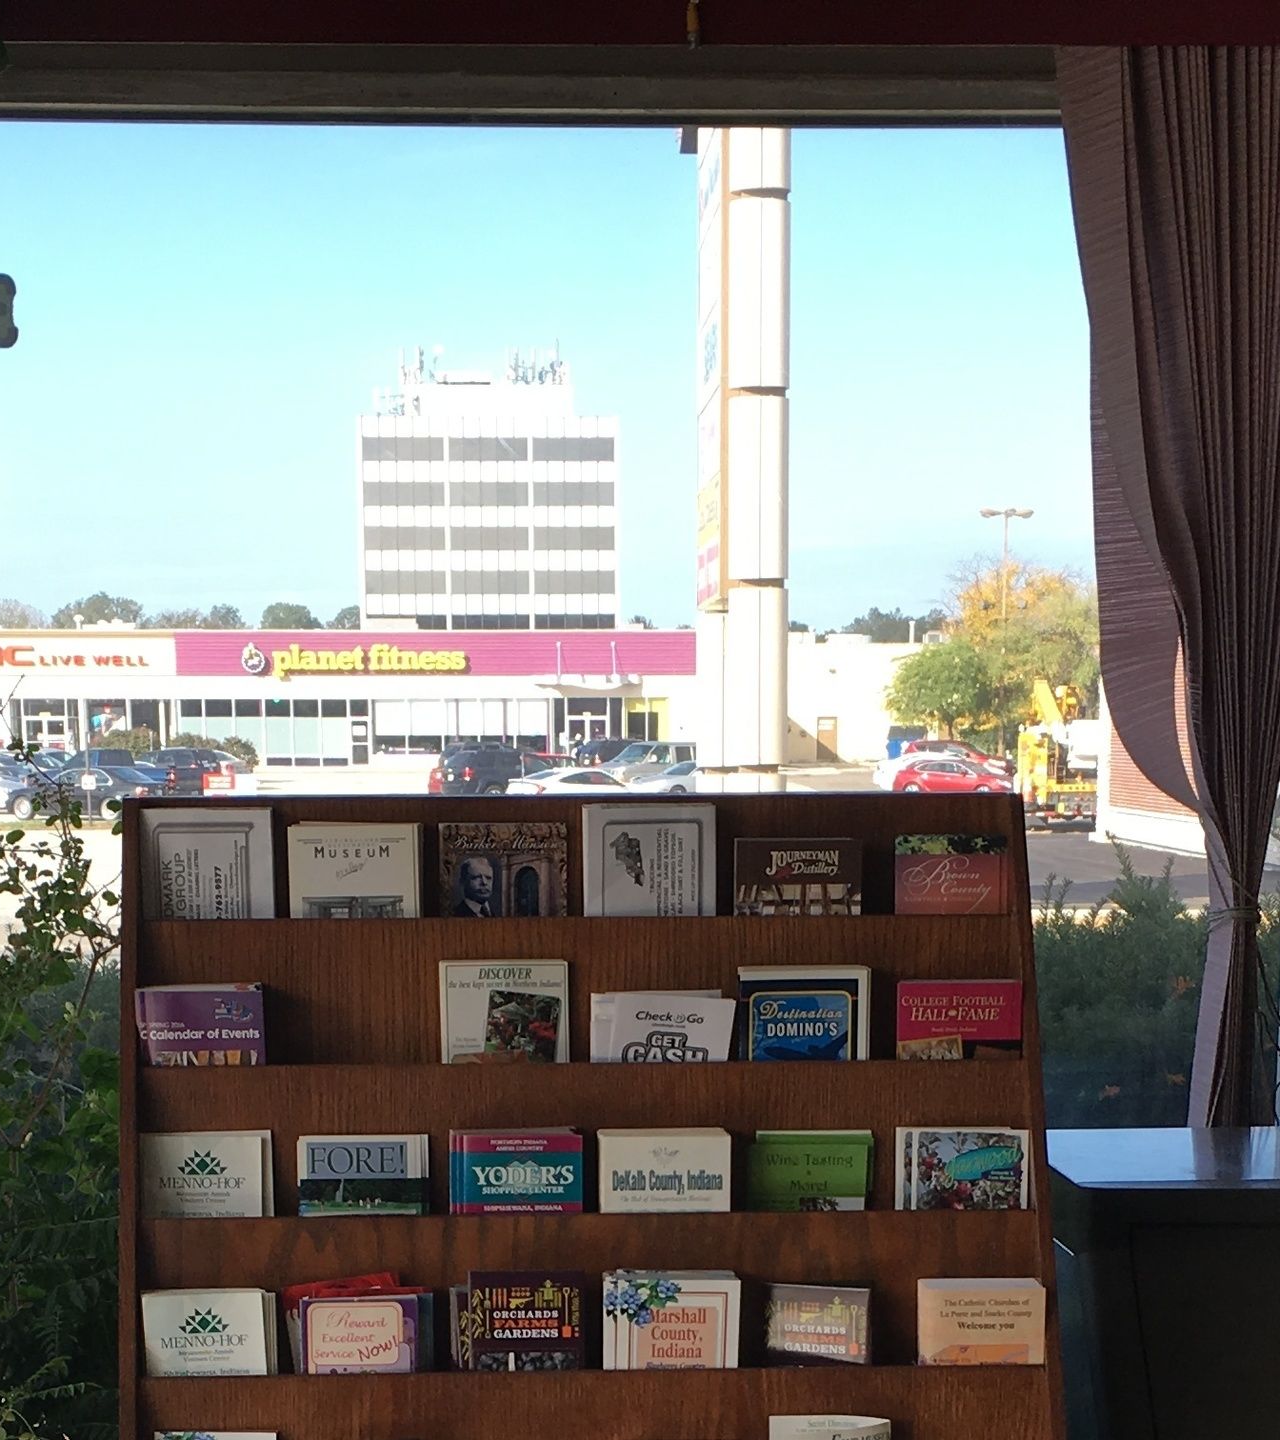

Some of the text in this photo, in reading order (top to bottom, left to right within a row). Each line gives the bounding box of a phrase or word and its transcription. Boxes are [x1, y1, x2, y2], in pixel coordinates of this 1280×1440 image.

[39, 655, 86, 667] LIVE
[93, 655, 149, 667] WELL
[272, 643, 466, 677] planet fitness
[314, 845, 390, 859] MUSEUM
[765, 850, 839, 876] JOURNEYMAN
[791, 861, 838, 876] Distillery
[162, 860, 175, 918] DMARK
[174, 852, 187, 912] GROUP
[940, 881, 992, 906] County
[478, 967, 532, 980] DISCOVER
[901, 995, 1006, 1006] COLLEGE FOOTBALL
[635, 1011, 673, 1022] Check
[686, 1013, 704, 1024] Go
[760, 1000, 843, 1020] Destination
[910, 1006, 1000, 1021] HALL FAME
[149, 1028, 205, 1040] Calendar
[207, 1028, 220, 1039] of
[221, 1028, 260, 1039] Events
[767, 1022, 838, 1037] DOMINO'S
[650, 1034, 683, 1048] GET
[625, 1045, 705, 1062] CASH
[309, 1145, 405, 1174] FORE!
[766, 1154, 854, 1168] Wine Tasting
[472, 1165, 574, 1186] YODER'S
[612, 1169, 723, 1195] DeKalb County, Indiana
[159, 1177, 246, 1190] MENNO-HOF
[481, 1186, 565, 1195] SHOPPING CENTER
[326, 1311, 388, 1328] Reward
[492, 1310, 559, 1319] ORCHARDS
[649, 1308, 706, 1324] Marshall
[493, 1319, 559, 1328] FARMS
[784, 1323, 847, 1335] ORCHARDS
[957, 1321, 1015, 1331] Welcome you
[160, 1334, 248, 1349] MENNO-HOF
[322, 1333, 375, 1344] Excellent
[493, 1329, 559, 1339] GARDENS
[651, 1325, 703, 1344] County,
[651, 1343, 702, 1359] Indiana
[784, 1342, 846, 1354] GARDENS
